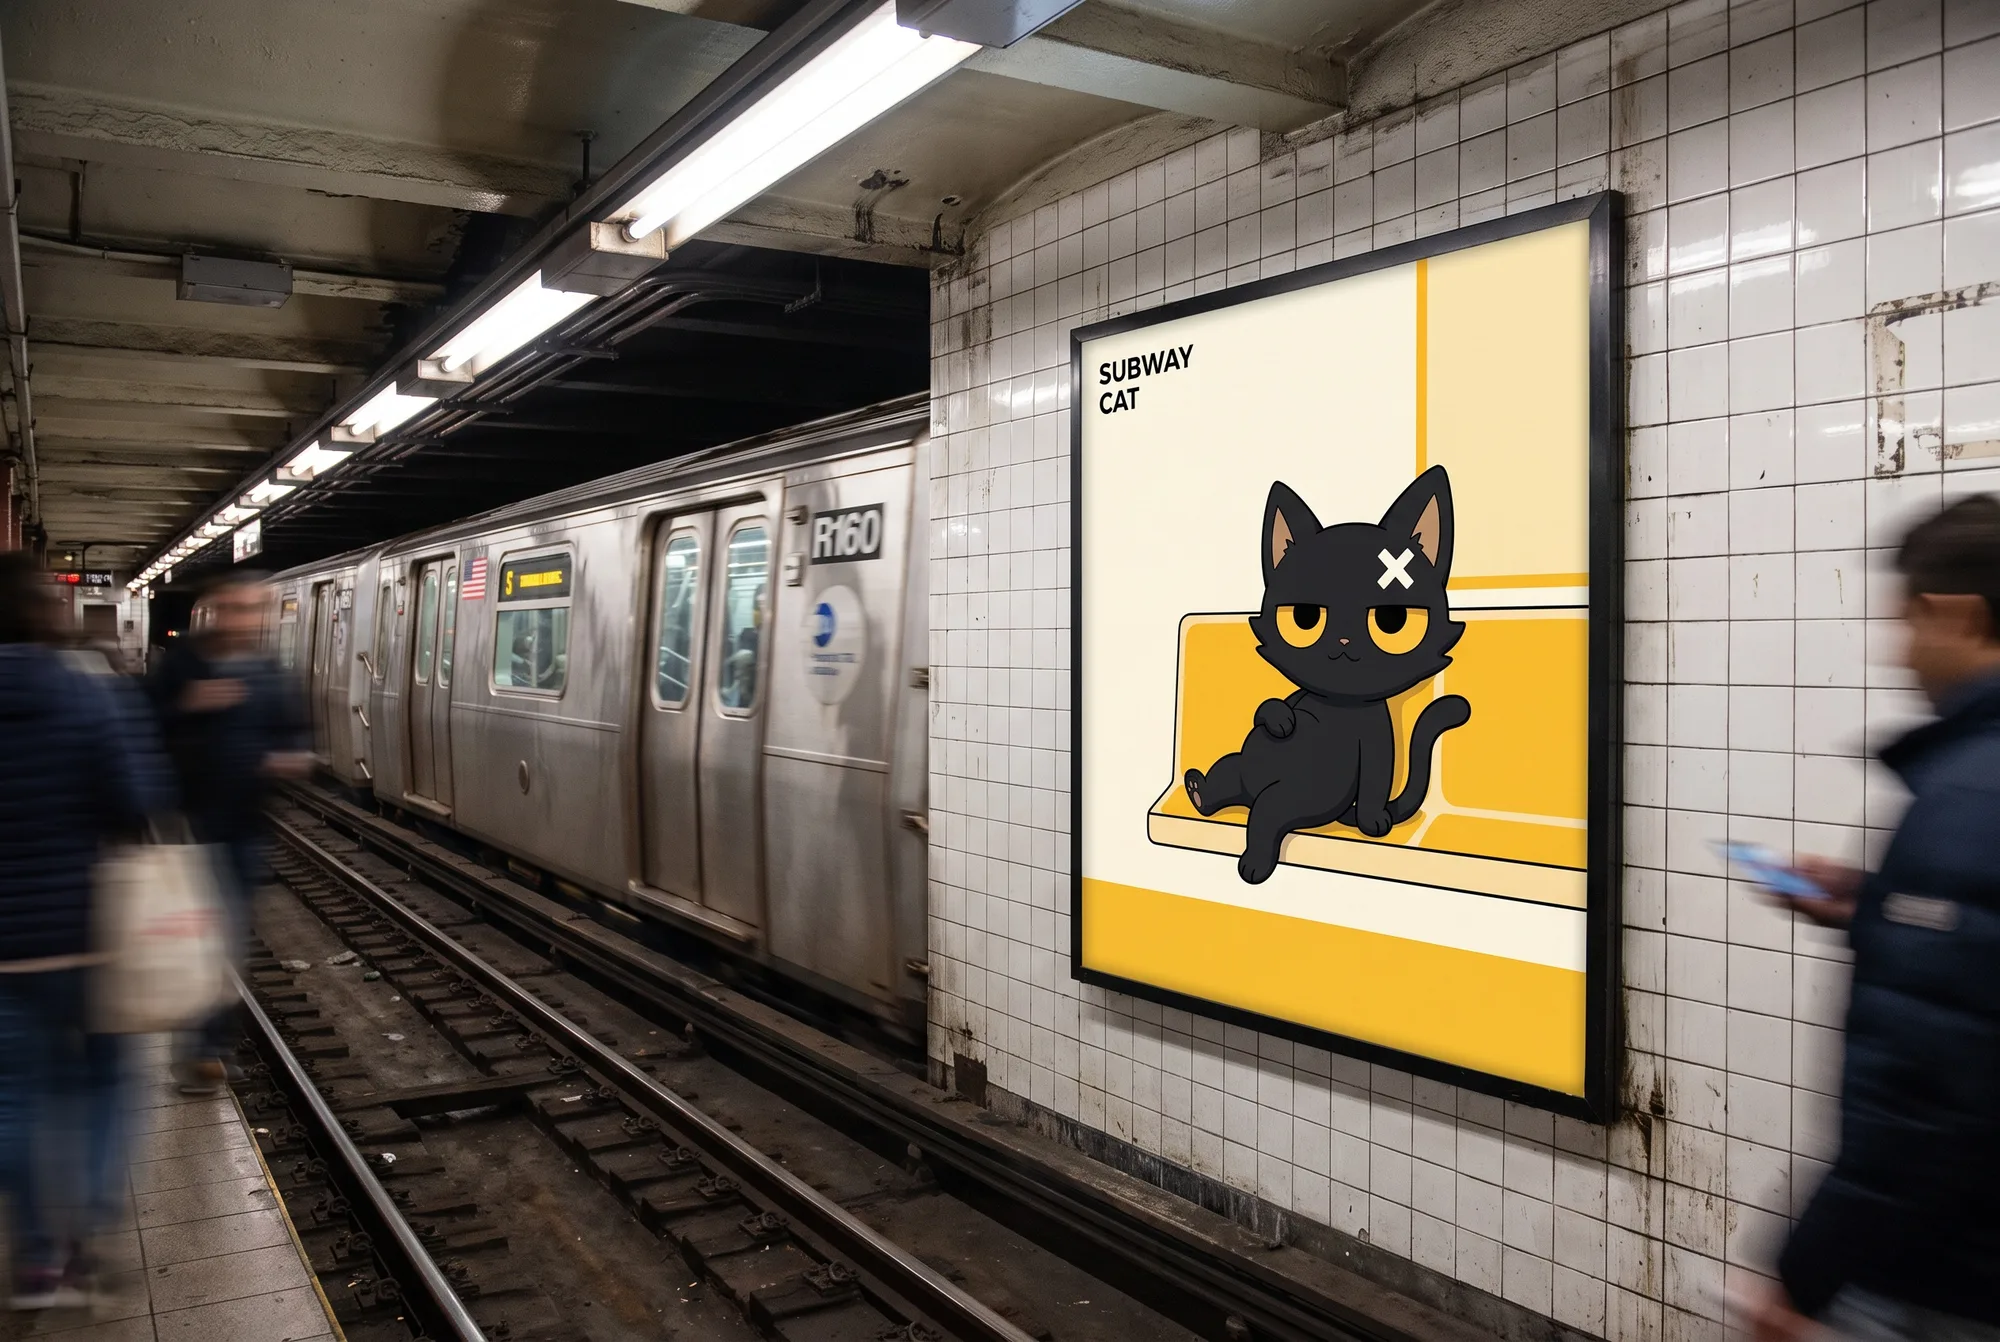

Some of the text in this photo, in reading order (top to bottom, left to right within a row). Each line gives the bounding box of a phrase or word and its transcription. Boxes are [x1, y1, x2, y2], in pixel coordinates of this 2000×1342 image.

[1099, 344, 1194, 385] SUBWAY
[1099, 386, 1140, 415] CAT
[812, 509, 882, 558] R160
